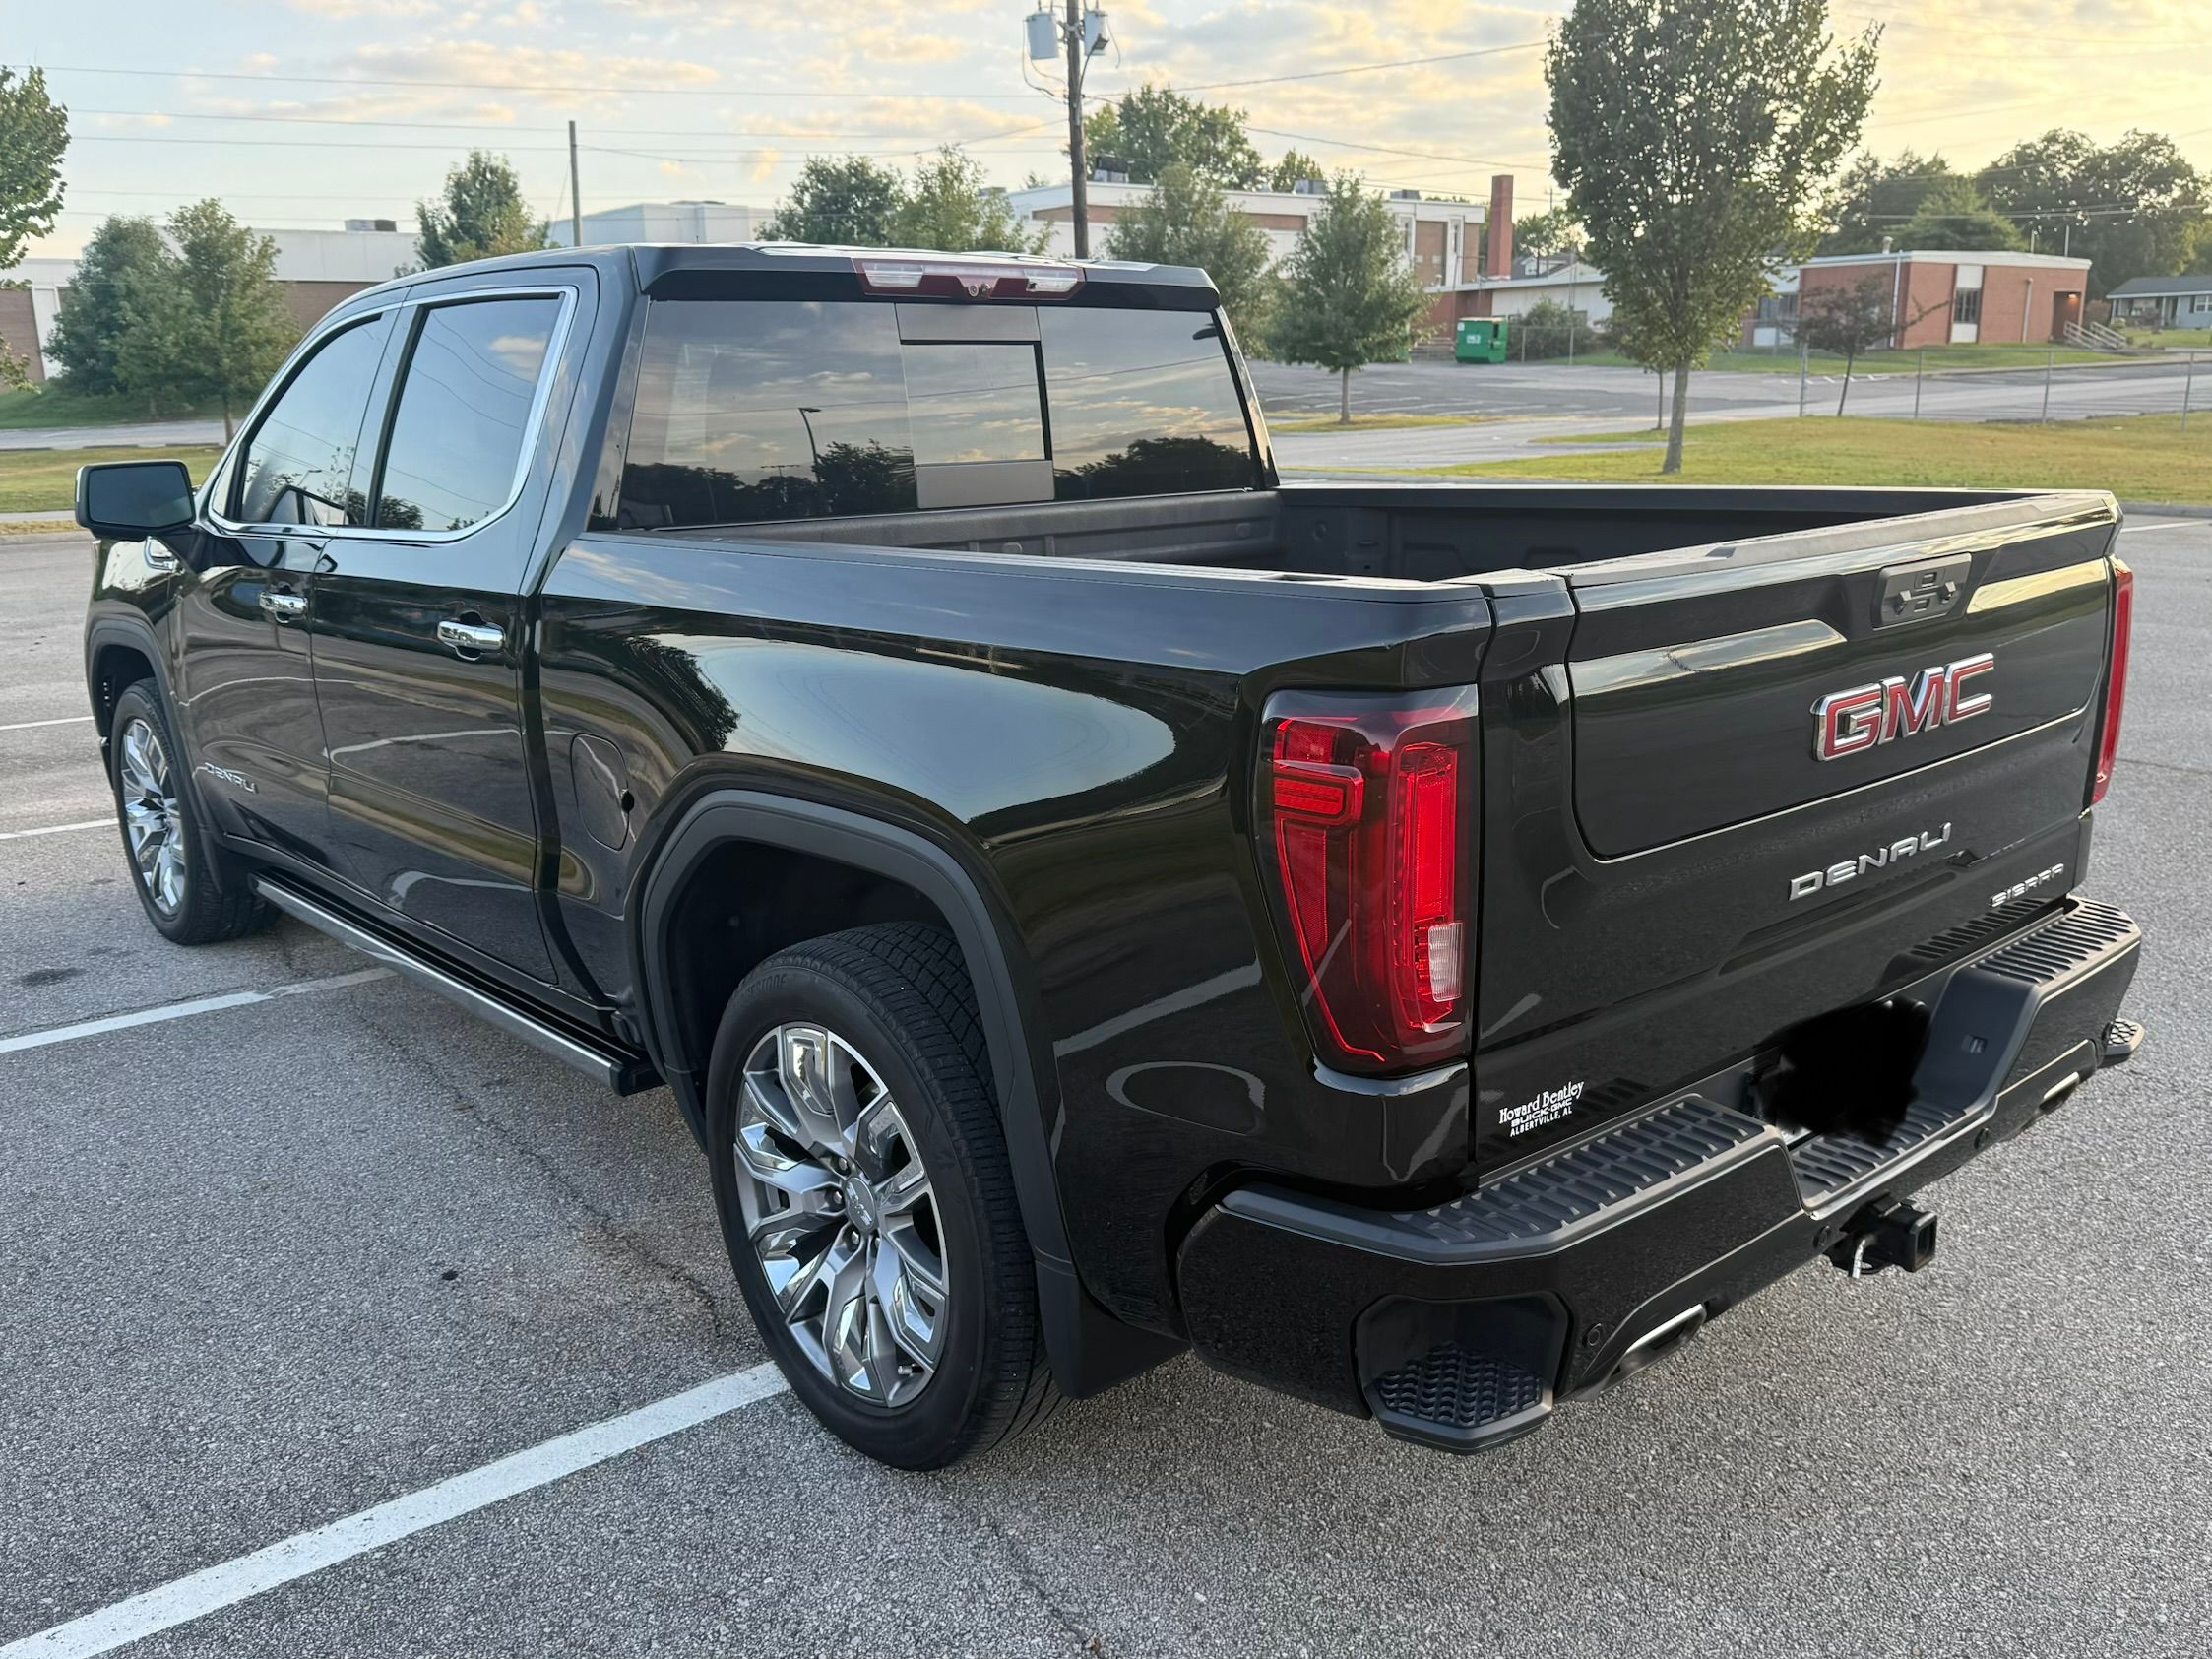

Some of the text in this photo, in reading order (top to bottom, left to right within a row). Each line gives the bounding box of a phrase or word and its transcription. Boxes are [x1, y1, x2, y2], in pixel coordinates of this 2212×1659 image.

[1809, 652, 1994, 762] GMC
[1788, 821, 1952, 901] DENALI
[1990, 862, 2064, 908] SIERRA
[1499, 1081, 1584, 1124] Howard Bentley
[1510, 1105, 1573, 1137] ALBERTVILLE, AL
